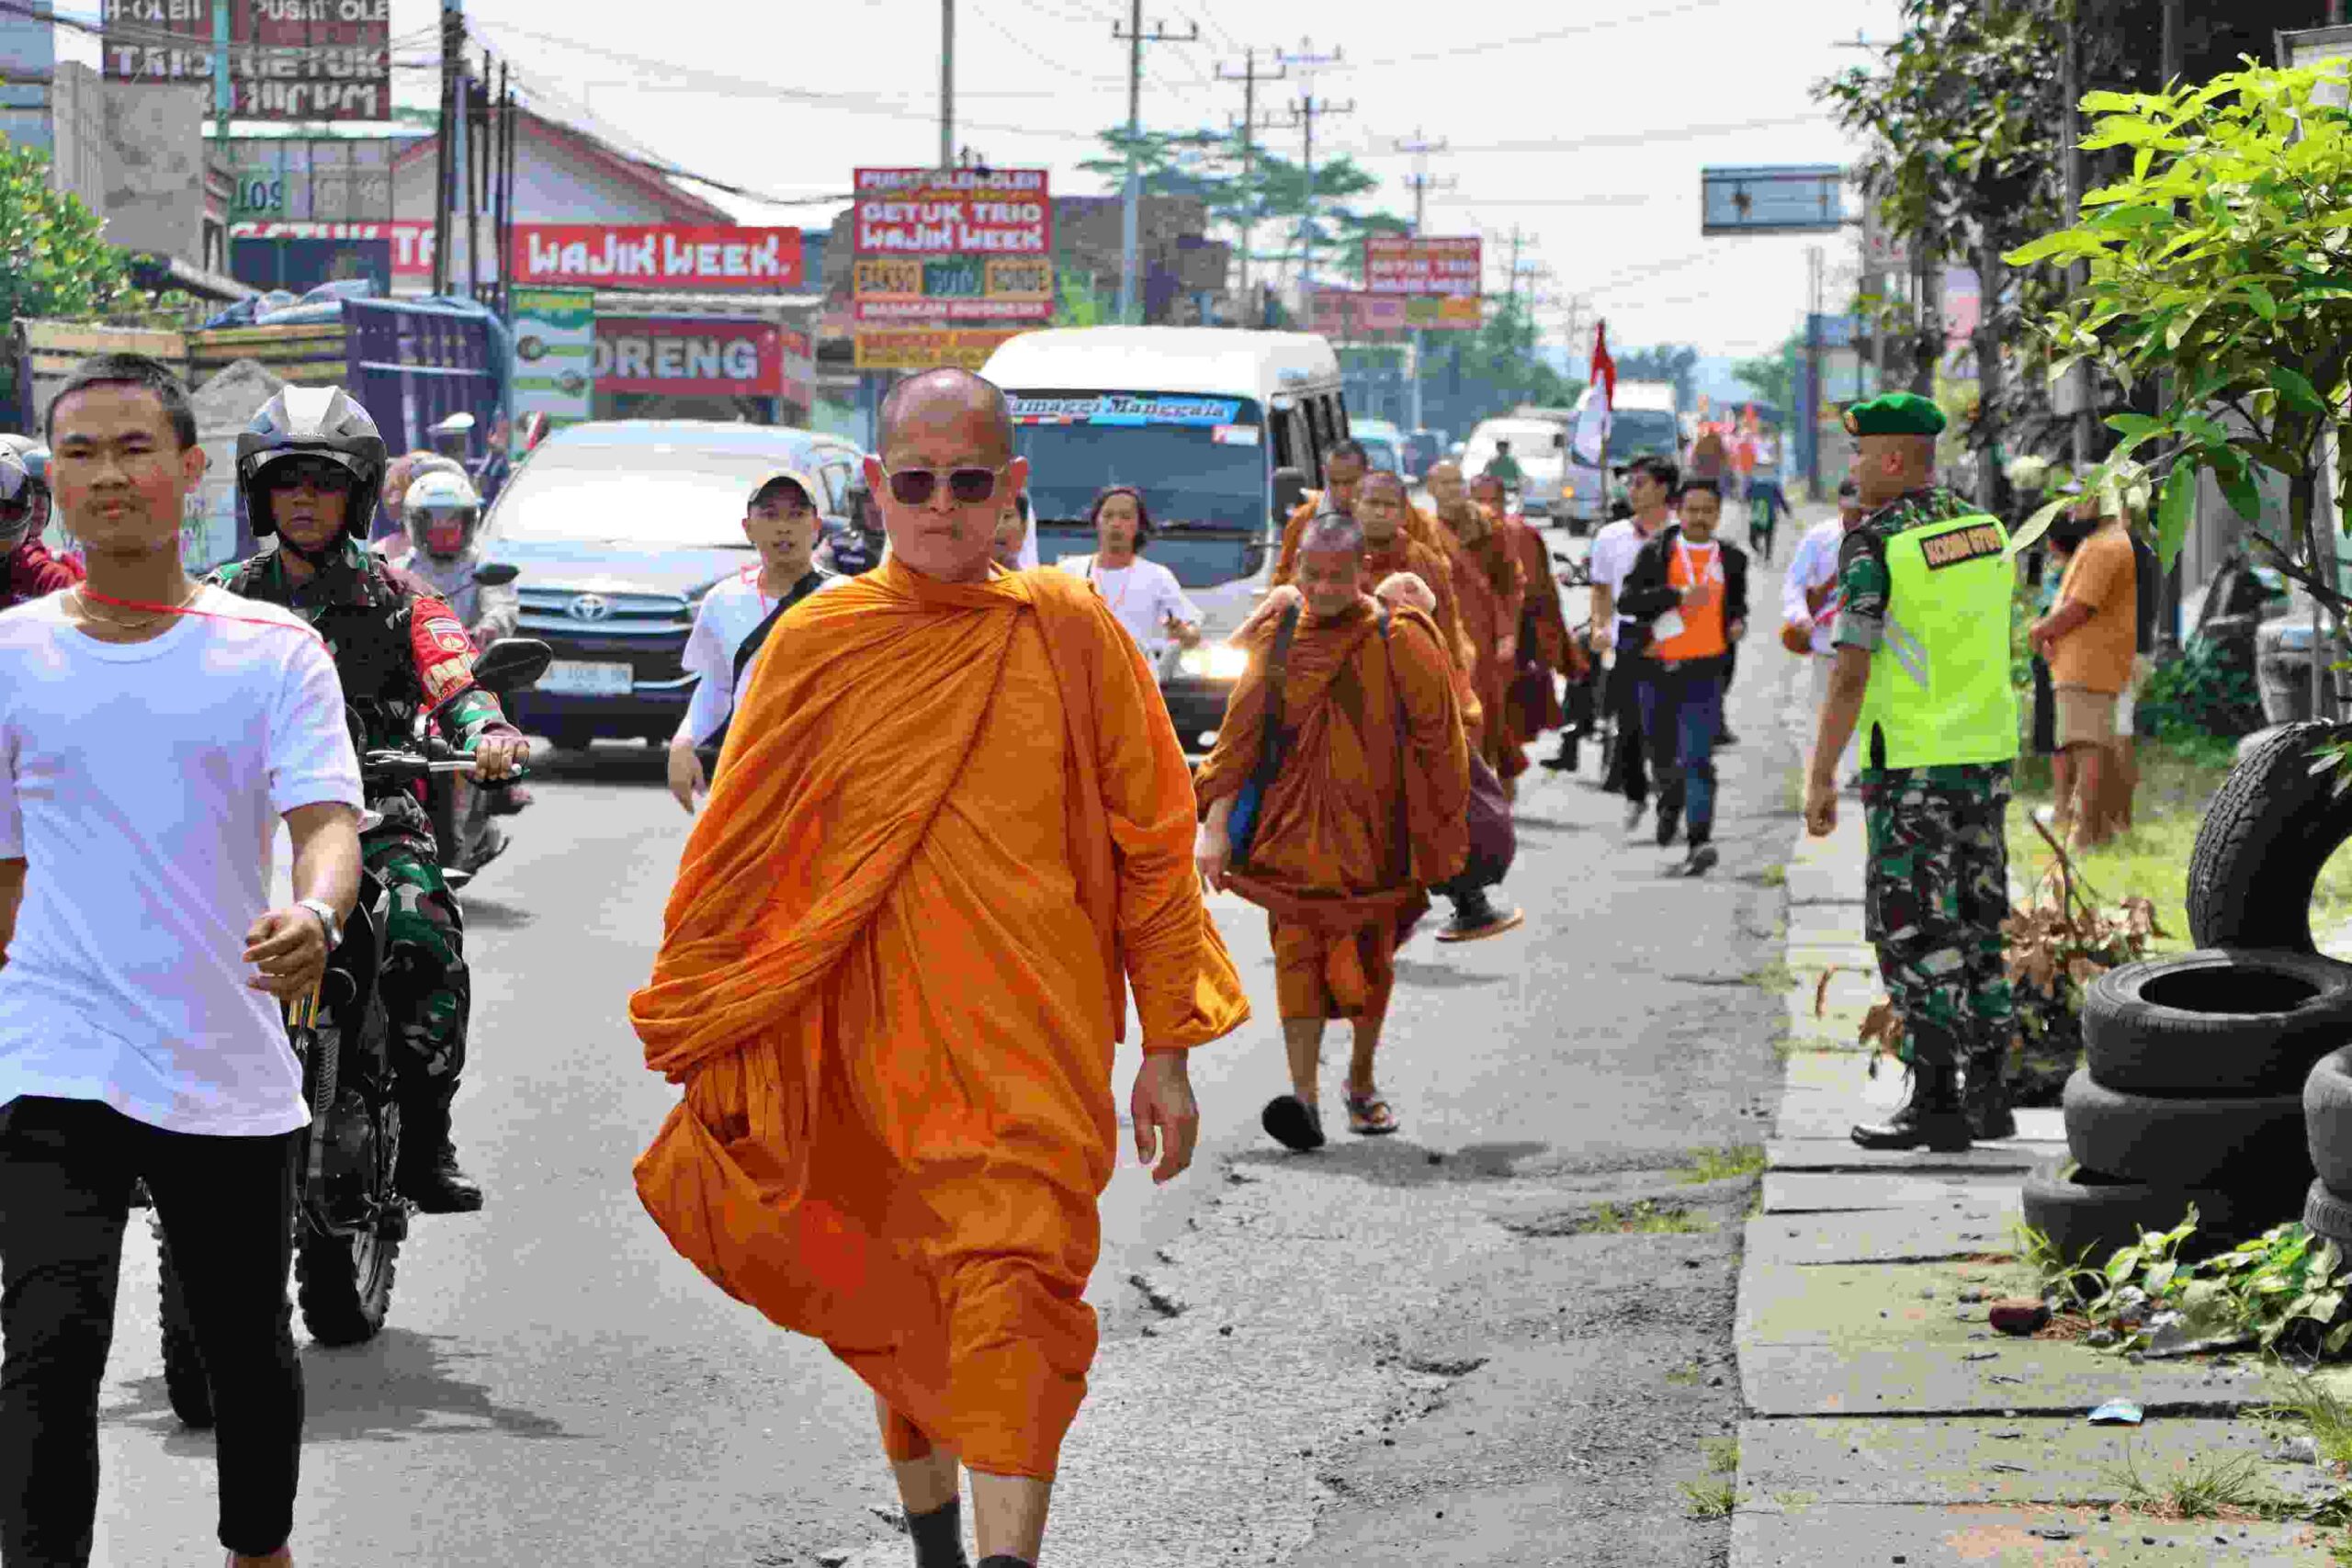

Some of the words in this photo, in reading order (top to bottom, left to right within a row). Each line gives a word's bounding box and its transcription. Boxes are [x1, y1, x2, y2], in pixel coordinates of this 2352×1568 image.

[862, 202, 964, 223] GETUK
[970, 202, 1043, 223] TRIO
[862, 223, 954, 250] WAJIK
[960, 223, 1043, 250] WEEK
[528, 231, 658, 275] WAJIK
